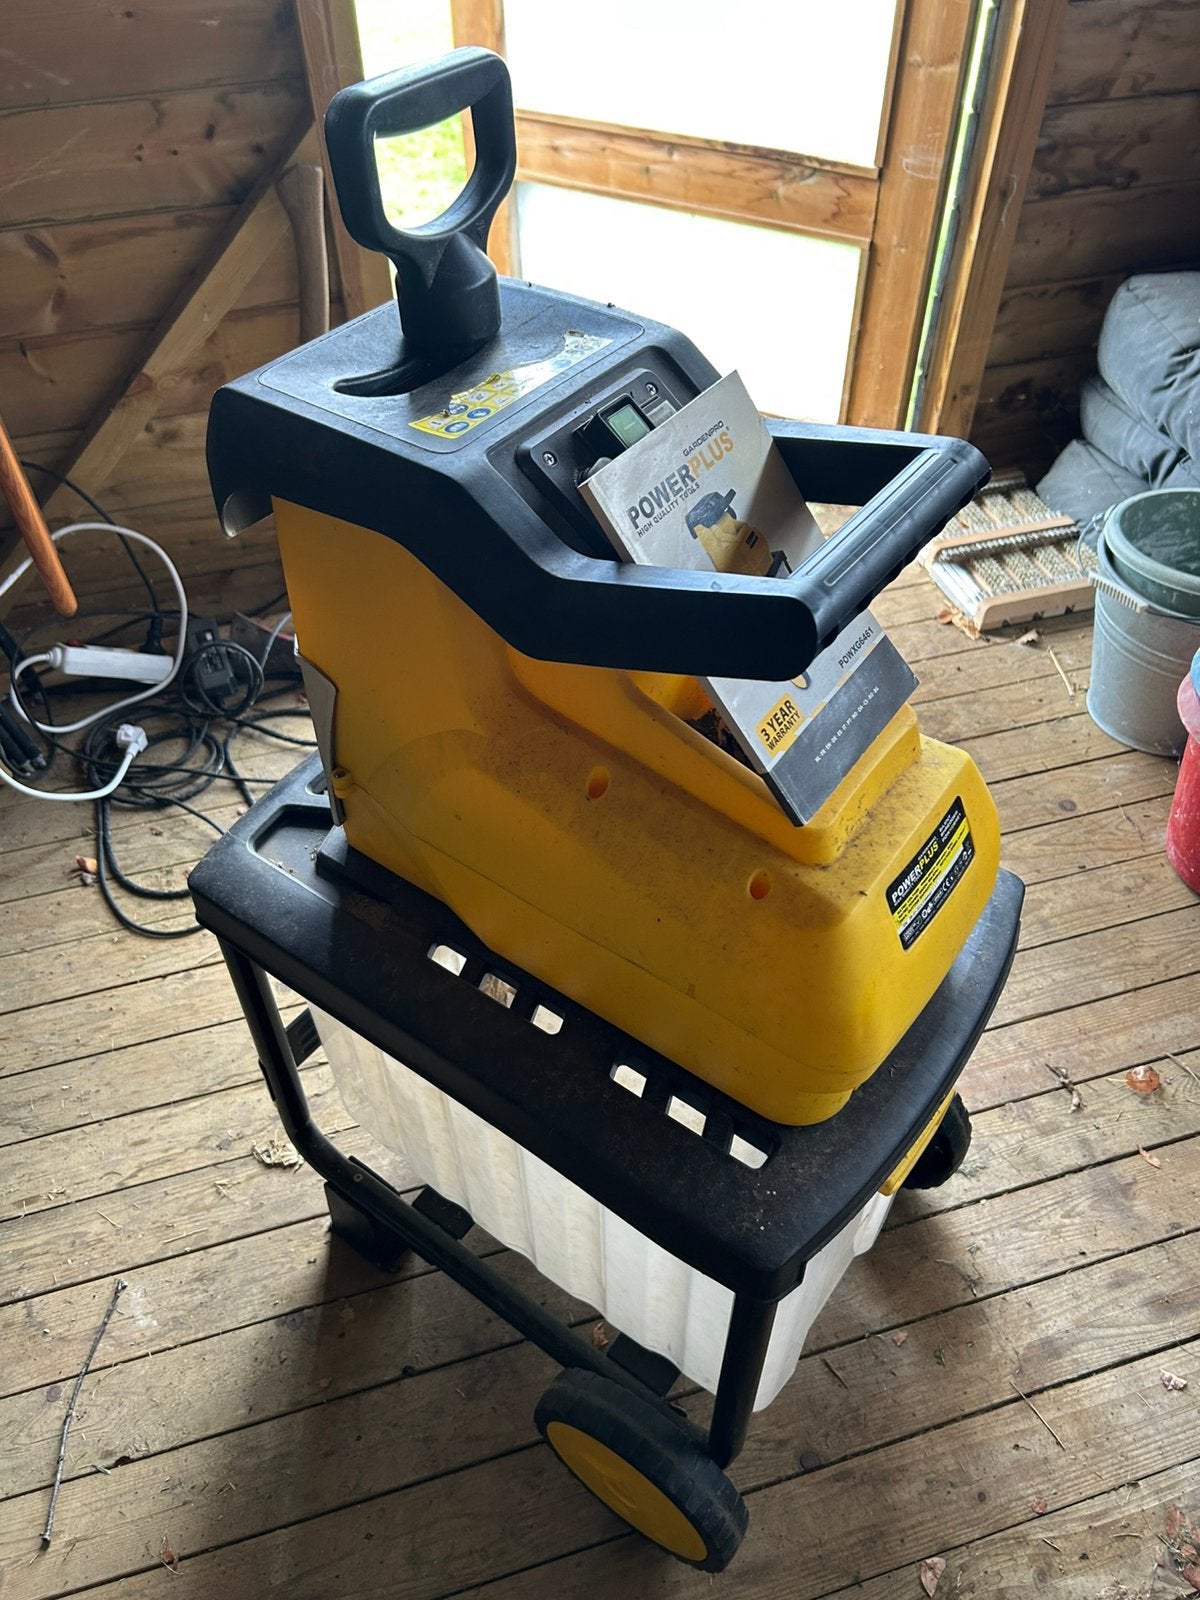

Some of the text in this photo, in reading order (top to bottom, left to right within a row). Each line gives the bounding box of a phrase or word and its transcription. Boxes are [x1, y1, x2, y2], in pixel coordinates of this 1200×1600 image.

[683, 420, 725, 457] GARDENPRO
[626, 431, 734, 530] POWERPLUS
[637, 482, 701, 538] HIGH QUALITY TOOLS
[838, 626, 874, 669] POWXG6461
[760, 700, 796, 742] 3 YEAR
[767, 710, 800, 750] WARRANTY
[891, 841, 939, 904] POWERPLUS
